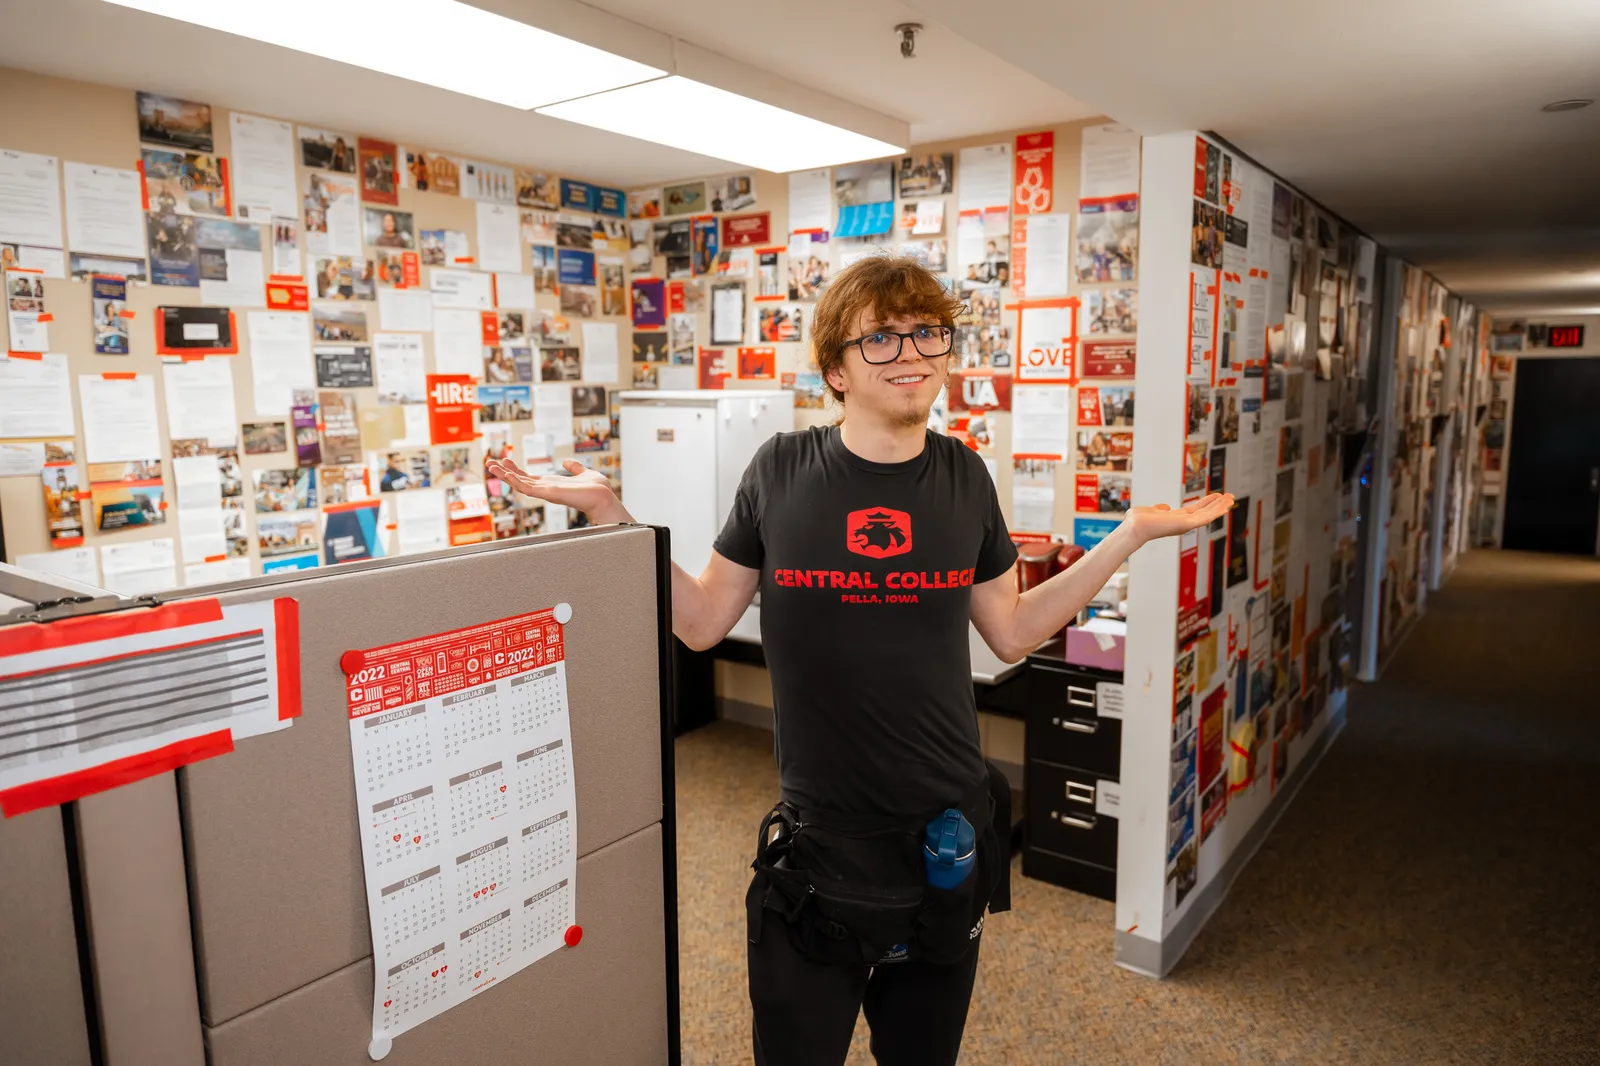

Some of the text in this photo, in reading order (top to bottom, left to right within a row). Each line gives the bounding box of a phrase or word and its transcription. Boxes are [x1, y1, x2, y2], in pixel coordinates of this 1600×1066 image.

[962, 376, 999, 406] UA
[775, 568, 878, 589] CENTRAL
[842, 594, 918, 604] PELLA, IOWA
[416, 655, 432, 666] YOU
[495, 653, 504, 664] C
[508, 647, 533, 664] 2022
[390, 660, 410, 669] CENTRAL
[391, 666, 411, 675] CENTRAL
[416, 666, 433, 674] OPEN
[350, 666, 385, 685] 2022
[524, 671, 544, 682] MARCH
[350, 688, 363, 701] C
[384, 685, 400, 694] DUTCH
[453, 688, 486, 703] FEBRUARY
[352, 706, 371, 716] NEVER
[378, 708, 412, 723] JANUARY
[533, 746, 548, 756] JUNE
[469, 769, 483, 779] MAY
[393, 794, 414, 806] APRIL
[529, 814, 561, 837] SEPTEMBER
[469, 842, 496, 859] AUGUST
[403, 874, 420, 887] JULY
[531, 883, 560, 903] DECEMBER
[468, 913, 503, 936] NOVEMBER
[400, 947, 435, 970] OCTOBER
